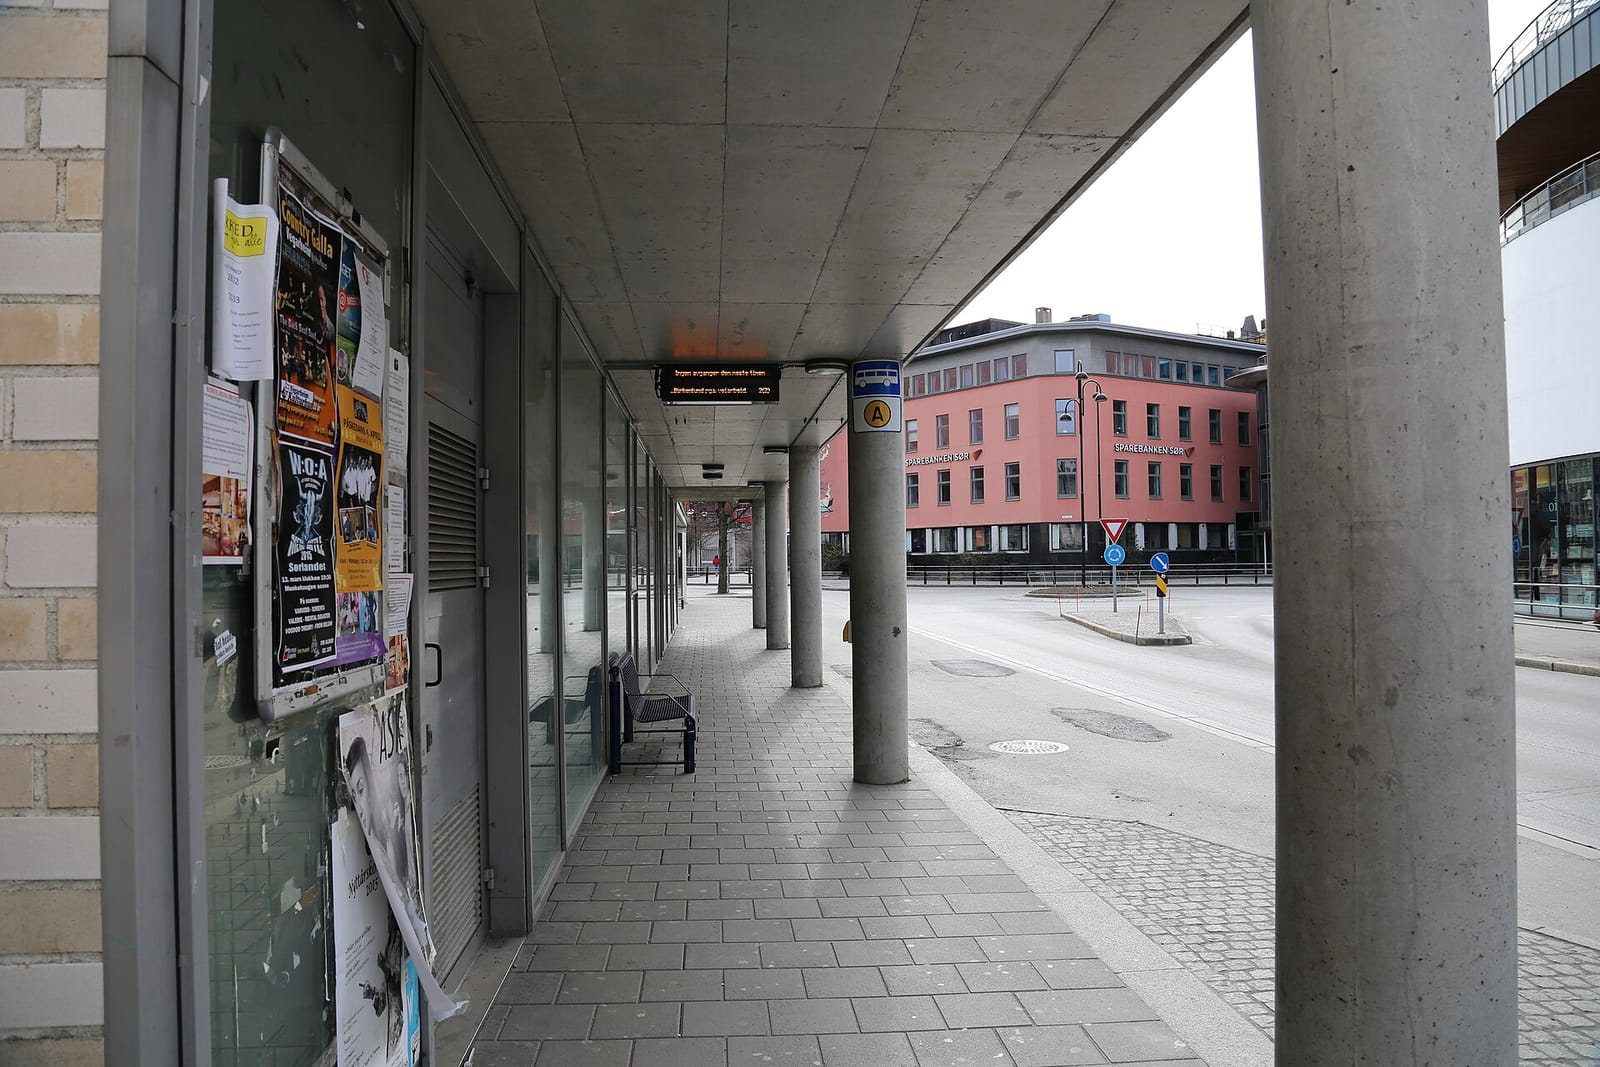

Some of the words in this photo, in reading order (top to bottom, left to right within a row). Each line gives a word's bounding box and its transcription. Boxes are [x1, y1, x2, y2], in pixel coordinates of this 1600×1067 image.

[281, 199, 311, 248] Country
[311, 227, 333, 259] Galla
[871, 405, 884, 422] A
[1114, 443, 1168, 455] SPAREBANKEN
[1169, 446, 1184, 456] SØR
[904, 453, 953, 467] SPAREBANKEN
[954, 452, 970, 462] SØR
[288, 562, 326, 573] Sørlandet
